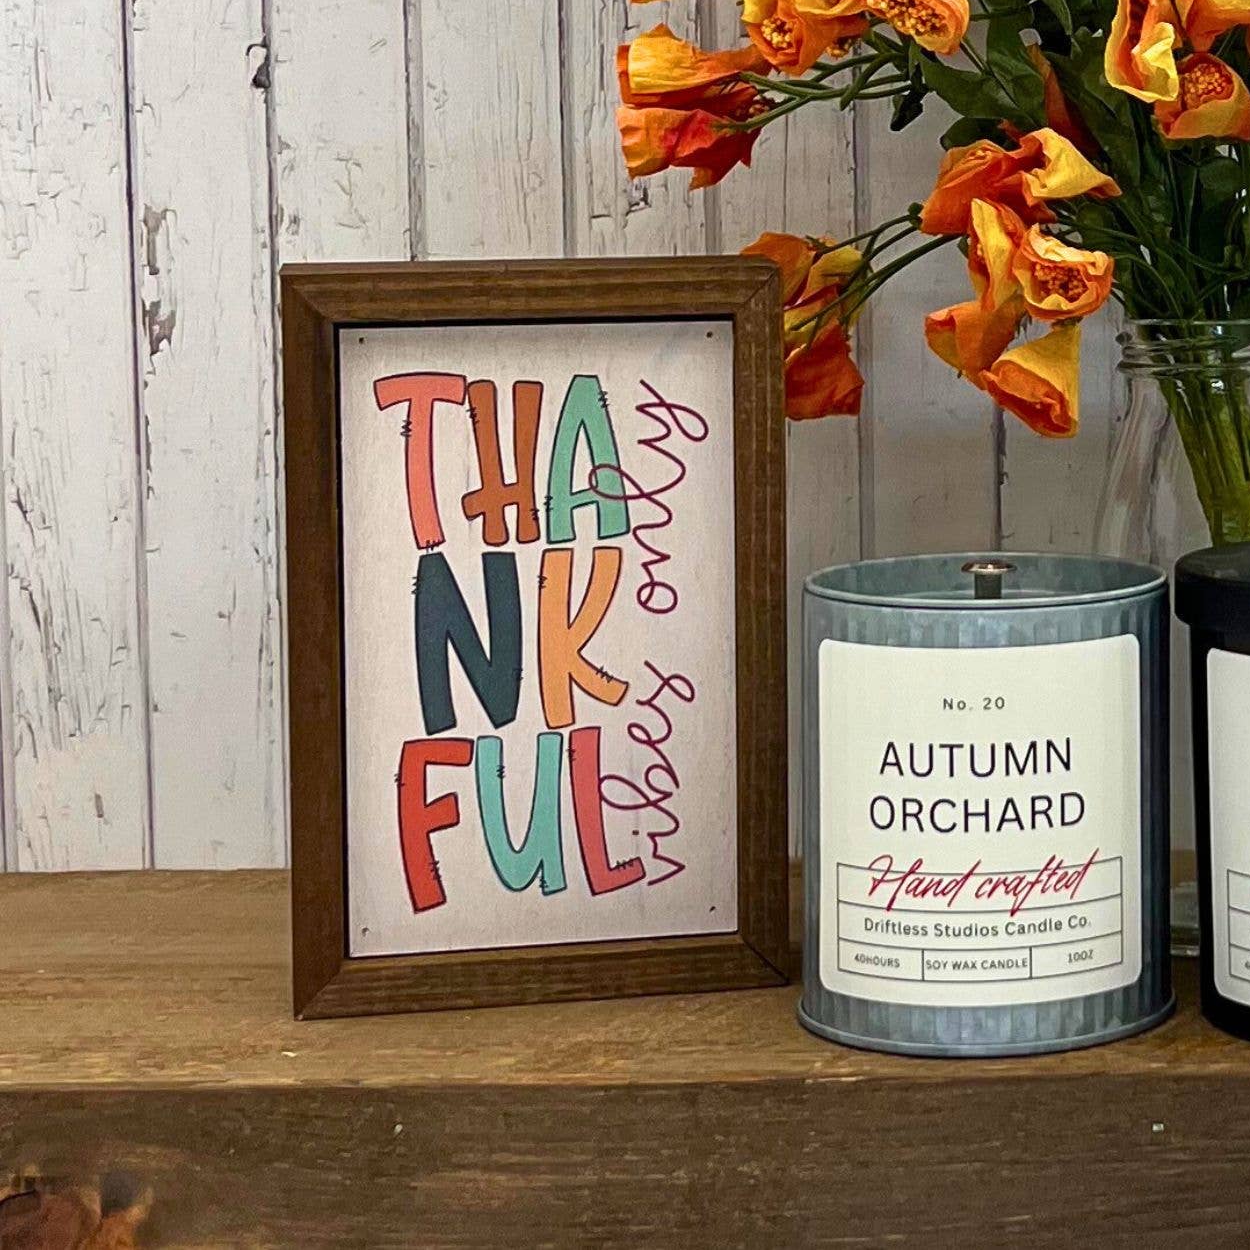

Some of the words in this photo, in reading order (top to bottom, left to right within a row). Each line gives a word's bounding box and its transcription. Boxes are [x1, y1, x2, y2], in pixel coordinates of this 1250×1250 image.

[588, 379, 710, 614] only
[942, 696, 974, 711] No.
[982, 696, 1007, 711] 20
[598, 661, 696, 887] vibes
[879, 736, 1073, 779] AUTUMN
[869, 791, 1086, 833] ORCHARD
[867, 854, 982, 911] Hand
[974, 848, 1100, 917] crafted
[864, 917, 929, 937] Driftless
[934, 923, 999, 938] Studios
[1004, 918, 1063, 937] Candle
[1067, 914, 1092, 929] Co.
[925, 959, 948, 971] SOY
[952, 959, 978, 971] WAX
[982, 958, 1029, 971] CANDLE
